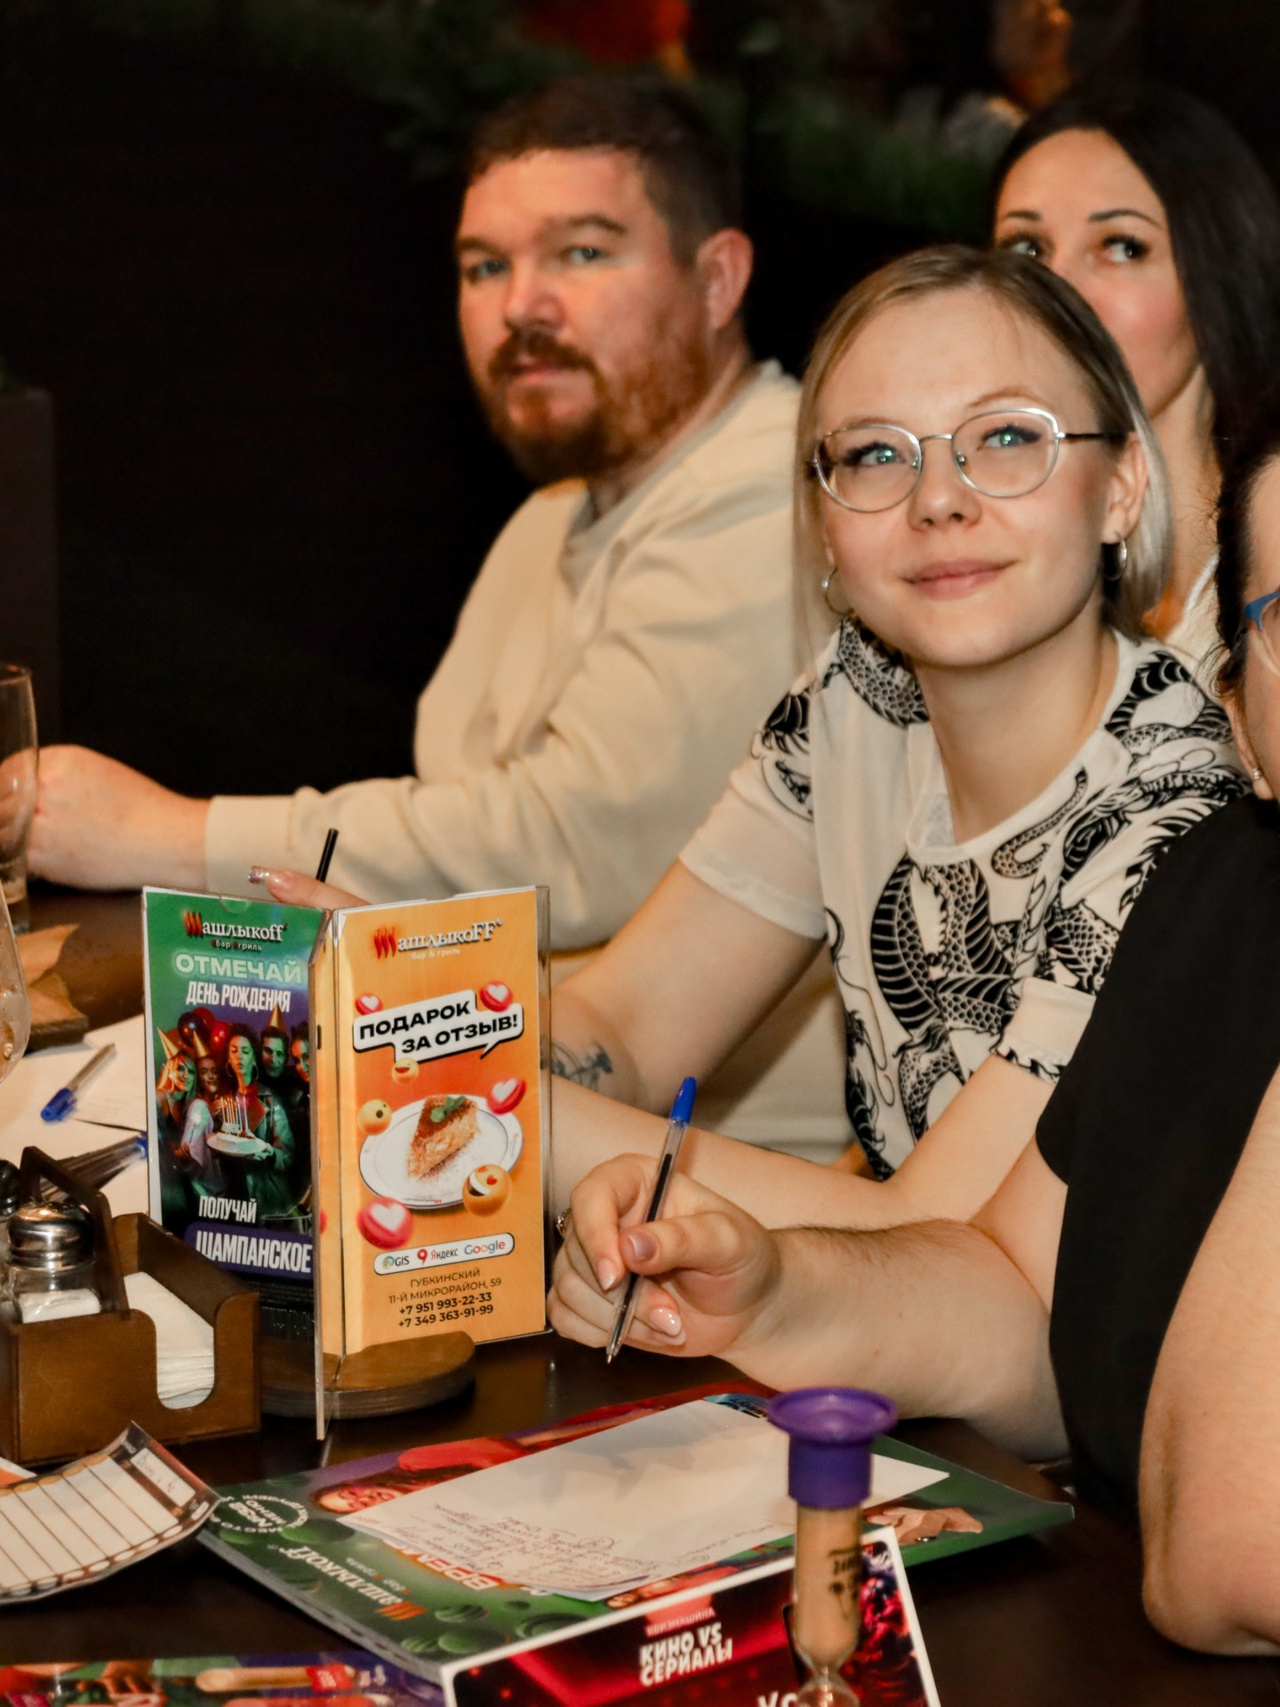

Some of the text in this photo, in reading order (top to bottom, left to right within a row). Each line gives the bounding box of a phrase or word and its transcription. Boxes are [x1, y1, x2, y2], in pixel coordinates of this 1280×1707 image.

[176, 954, 302, 984] ОТМЕЧАЙ
[186, 981, 291, 1012] ДЕНЬ РОЖДЕНИЯ
[360, 1001, 471, 1040] ПОДАРОК
[401, 1014, 518, 1053] ЗА ОТЗЫВ!
[198, 1195, 257, 1223] ПОЛУЧАЙ
[196, 1230, 312, 1273] ШАМПАНСКОЕ
[431, 1248, 459, 1261] Яндекс
[464, 1240, 505, 1255] Google
[410, 1267, 481, 1288] ГУБКИНСКИЙ
[490, 1277, 502, 1288] 59
[399, 1304, 494, 1328] +7 349 363-91-99
[400, 1292, 492, 1315] +7 951 993-22-33
[640, 1622, 722, 1666] КИНО VS
[640, 1638, 733, 1687] СЕРИАЛЫ
